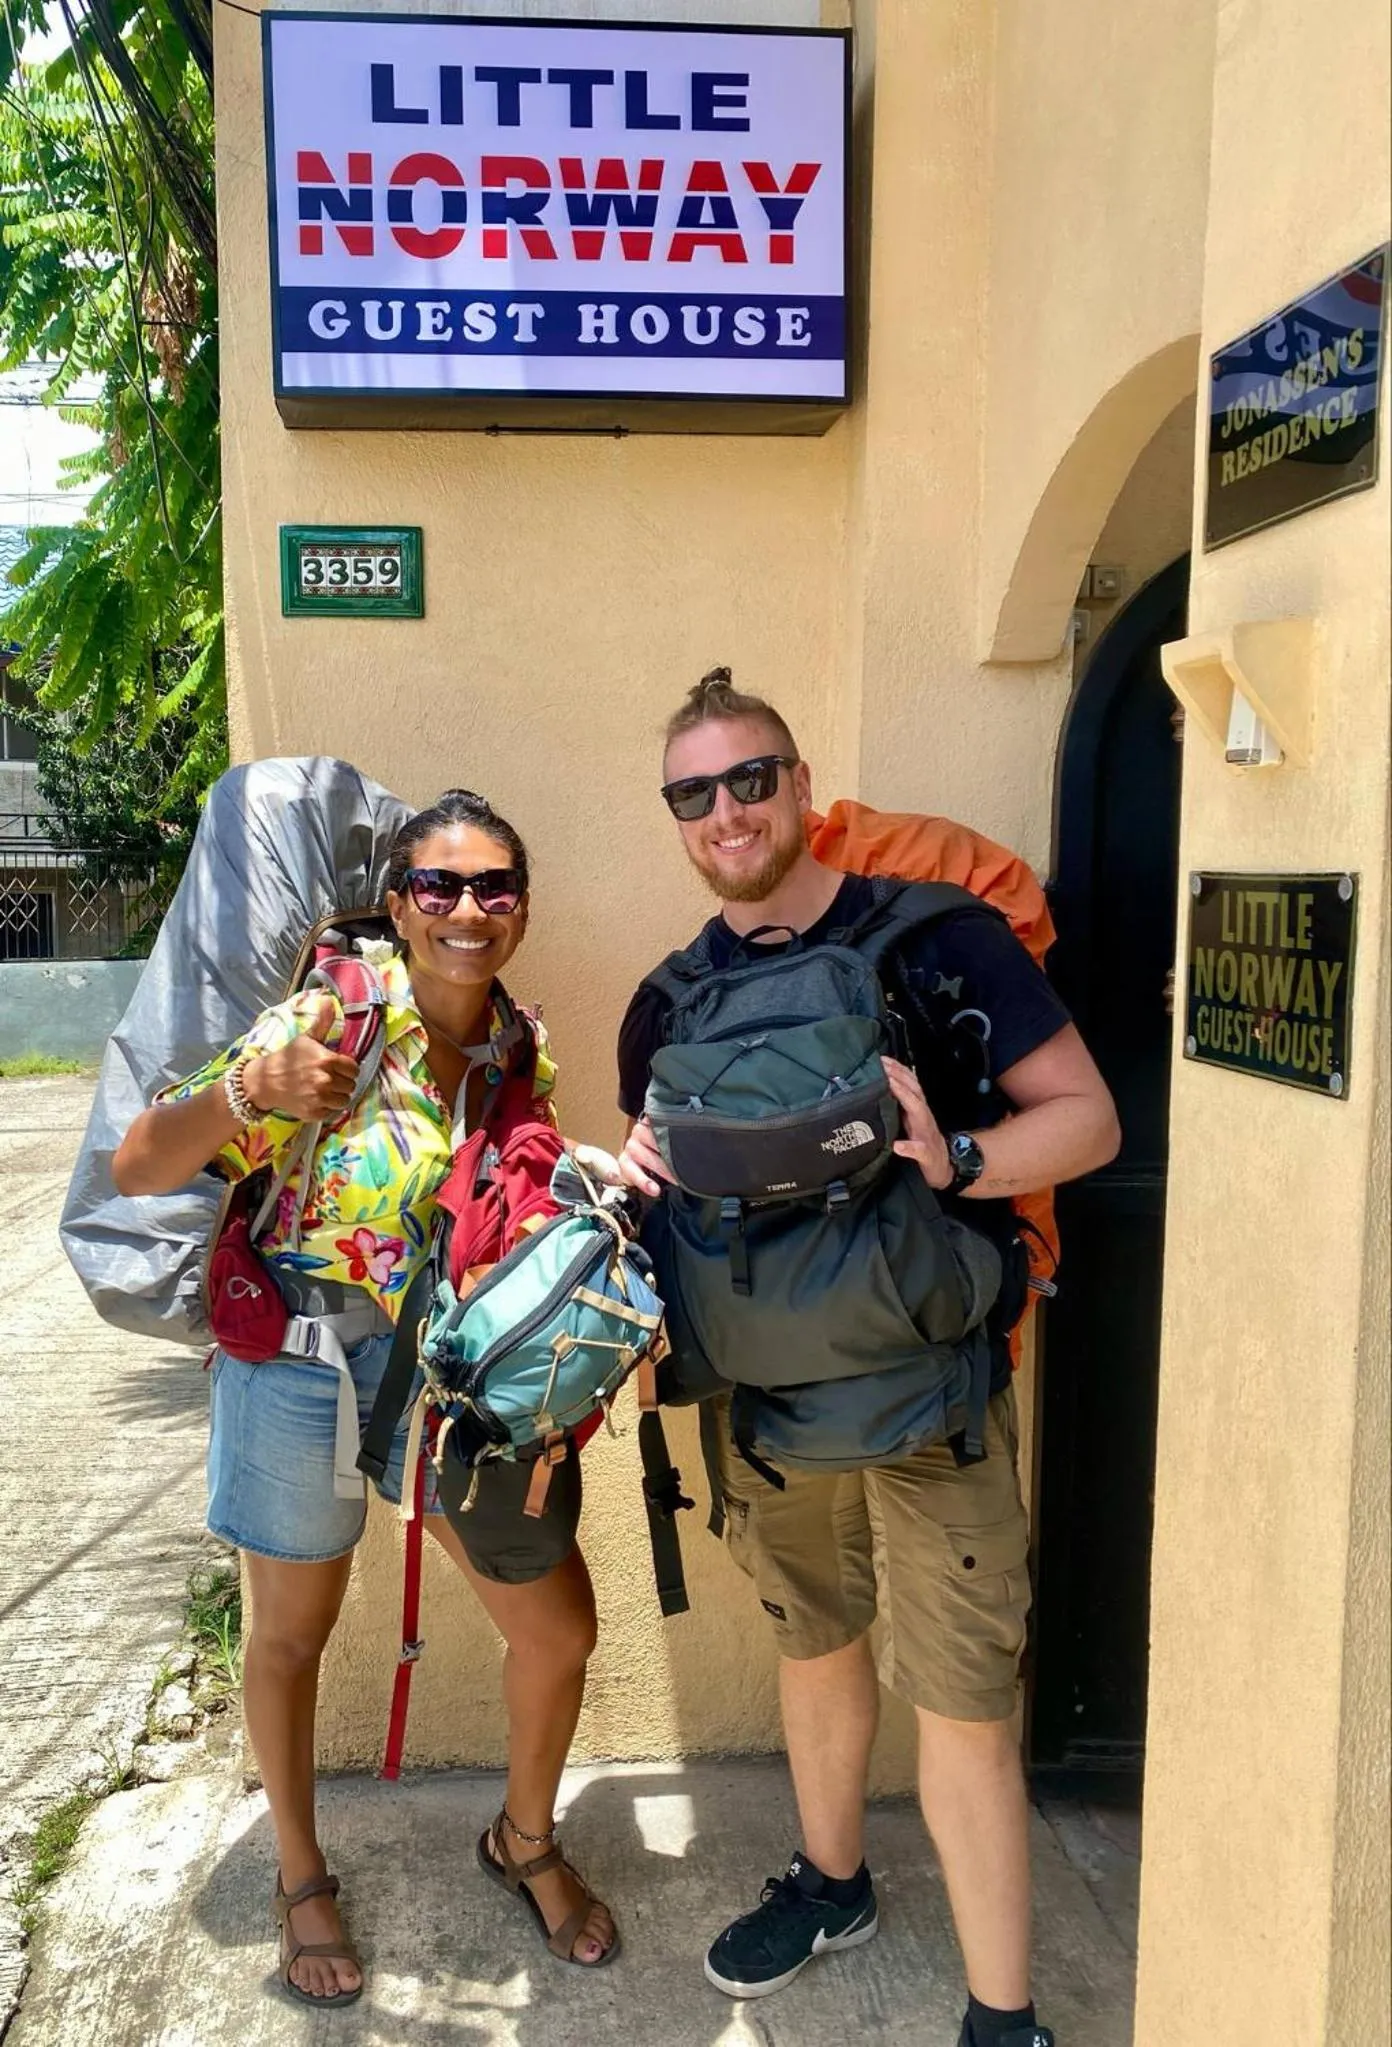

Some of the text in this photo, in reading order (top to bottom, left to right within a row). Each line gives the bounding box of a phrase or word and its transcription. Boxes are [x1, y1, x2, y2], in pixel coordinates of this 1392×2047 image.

[370, 63, 751, 132] LITTLE
[297, 150, 822, 265] NORWAY
[308, 299, 812, 346] GUEST HOUSE
[1221, 327, 1364, 439] JONASSEN'S
[1221, 386, 1359, 487] RESIDENCE
[303, 557, 400, 585] 3359
[1221, 890, 1314, 950] LITTLE
[1194, 947, 1343, 1019] NORWAY
[1197, 1004, 1334, 1076] GUEST HOUSE
